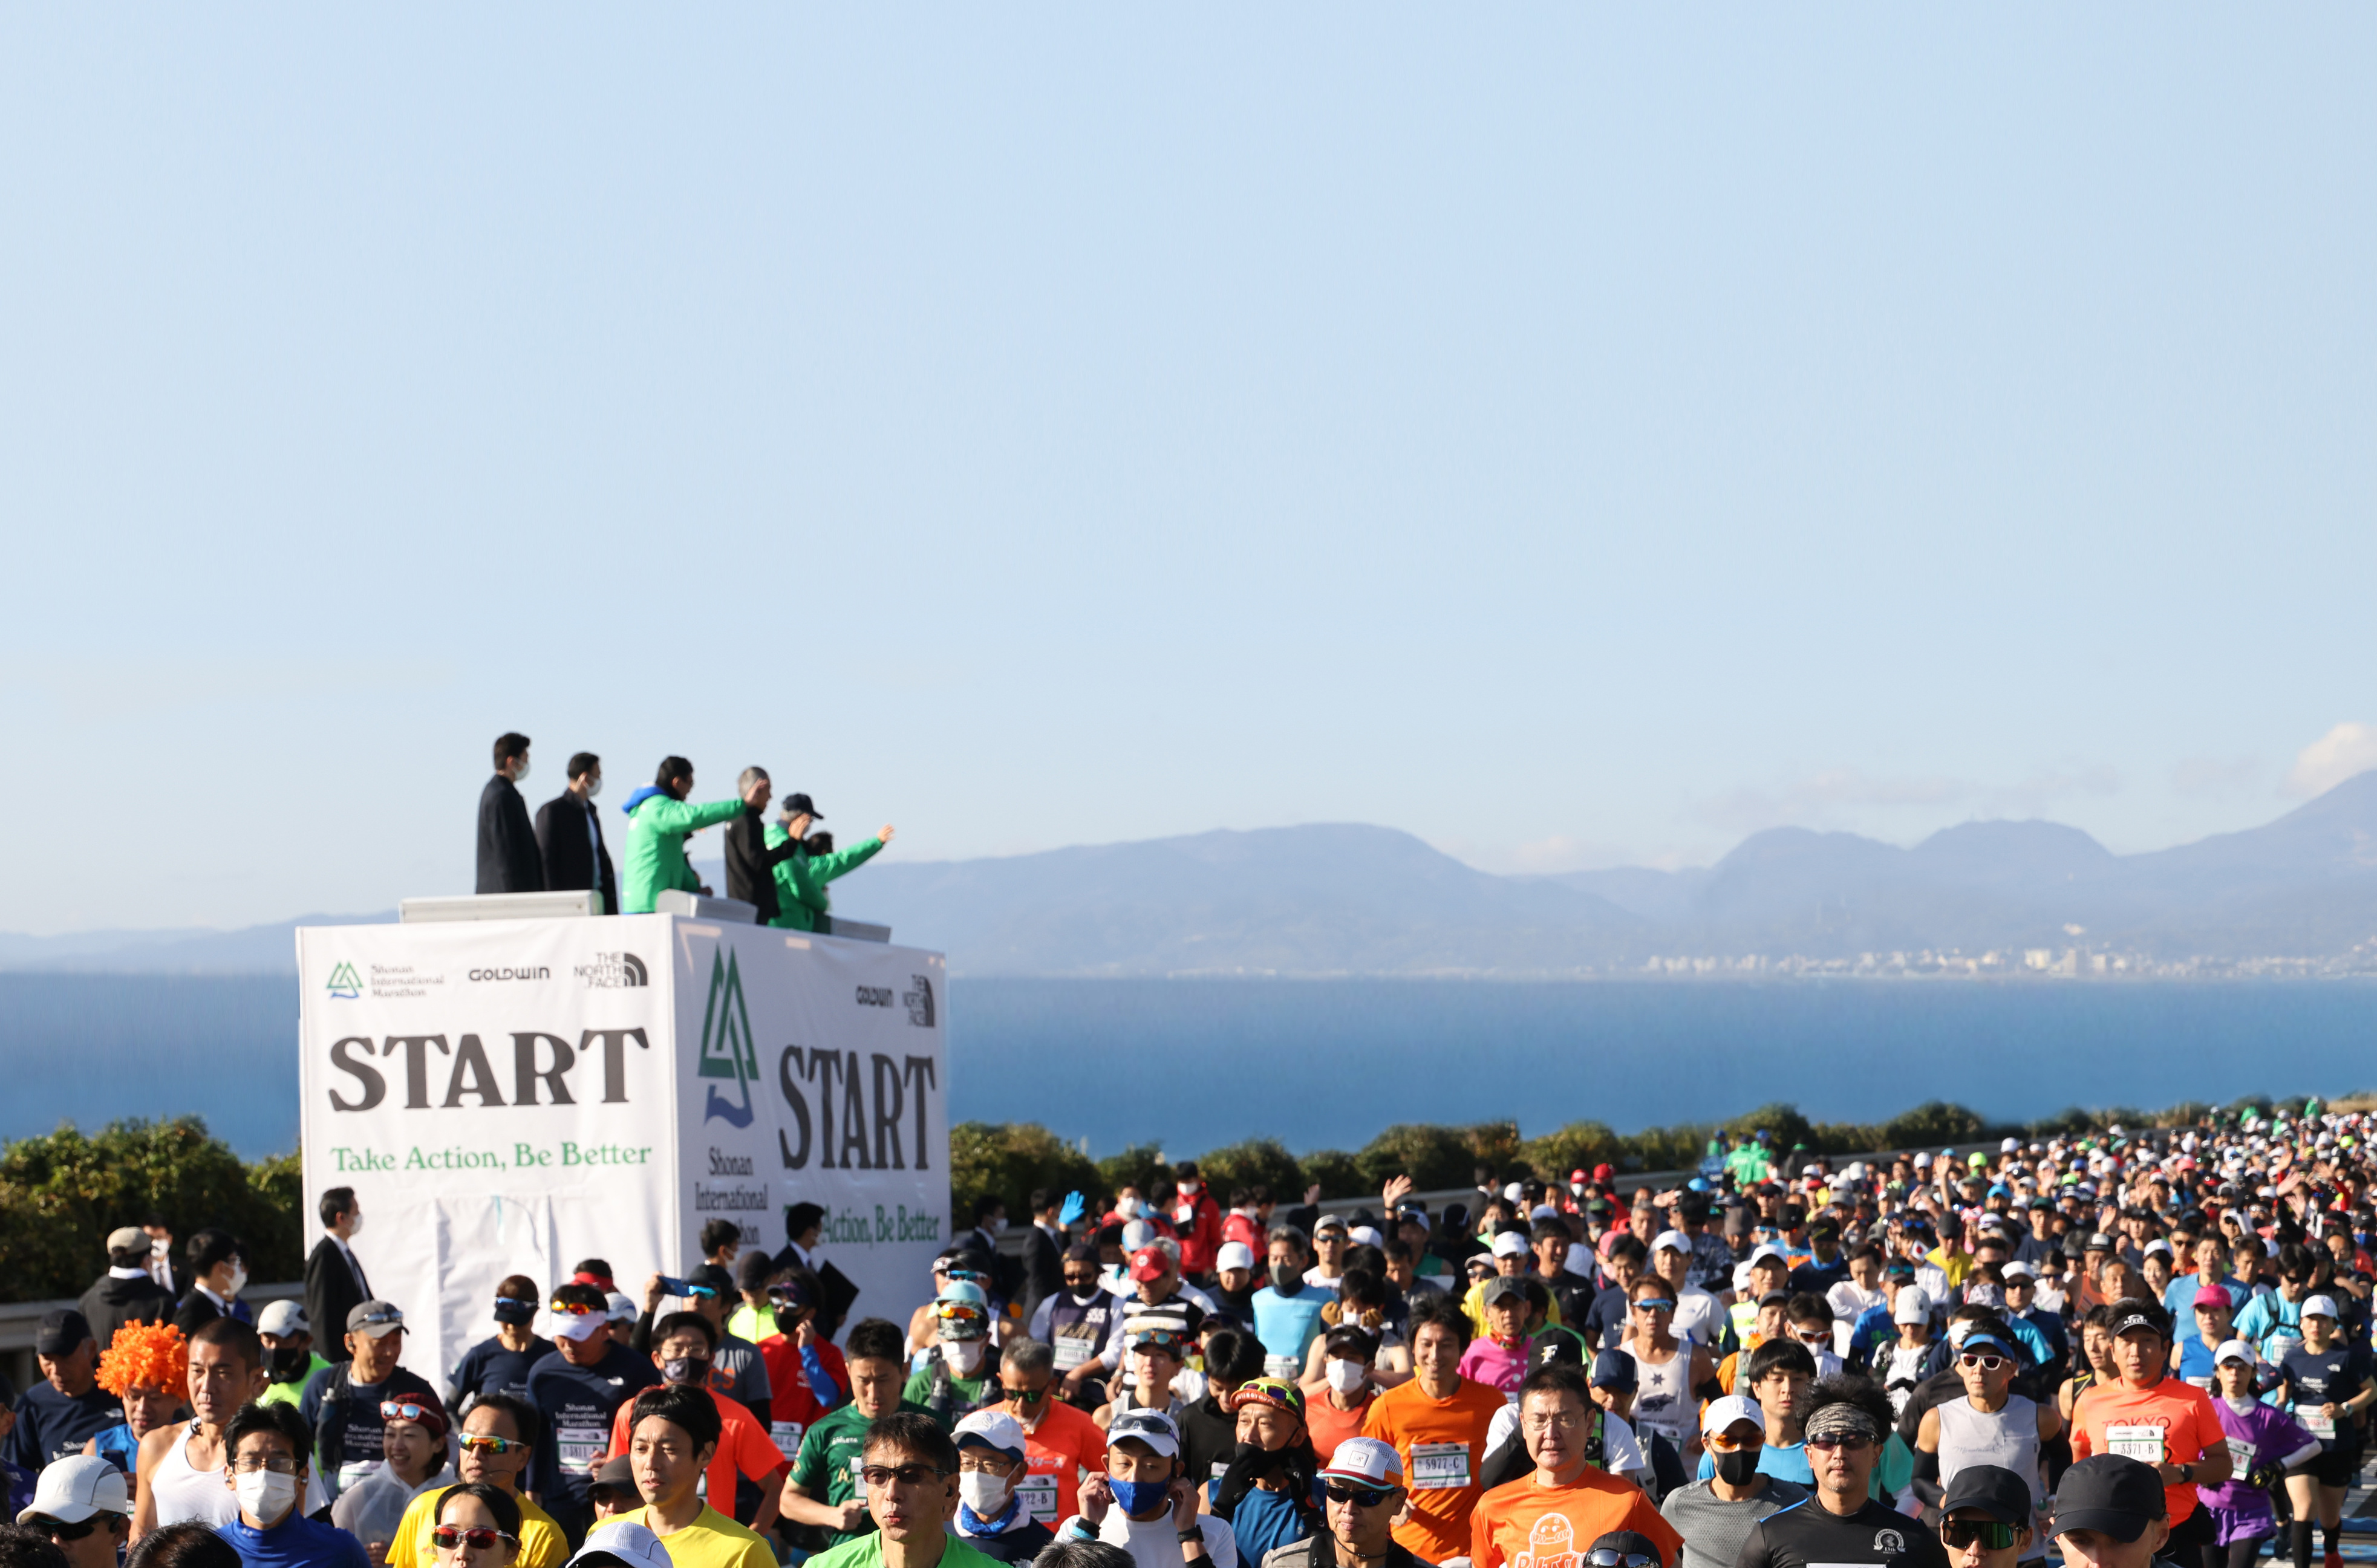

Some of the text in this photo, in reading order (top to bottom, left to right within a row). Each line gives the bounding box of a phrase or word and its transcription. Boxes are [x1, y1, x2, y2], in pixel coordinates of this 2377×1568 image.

[596, 952, 621, 964] THE
[371, 964, 414, 974] Shonan
[469, 967, 550, 981] GOLDWIN
[574, 965, 621, 977] NORTH
[371, 975, 445, 987] International
[587, 975, 621, 989] FACE
[372, 987, 427, 999] Marathon
[328, 1027, 650, 1113] START
[779, 1045, 936, 1171] START
[331, 1142, 653, 1172] Take Action, Be Better
[708, 1147, 754, 1176] Shonan
[695, 1182, 768, 1211] International
[875, 1204, 895, 1243] Be
[897, 1203, 941, 1241] Better
[565, 1403, 596, 1412] Shonan
[555, 1411, 607, 1420] International
[562, 1419, 601, 1428] Marathon
